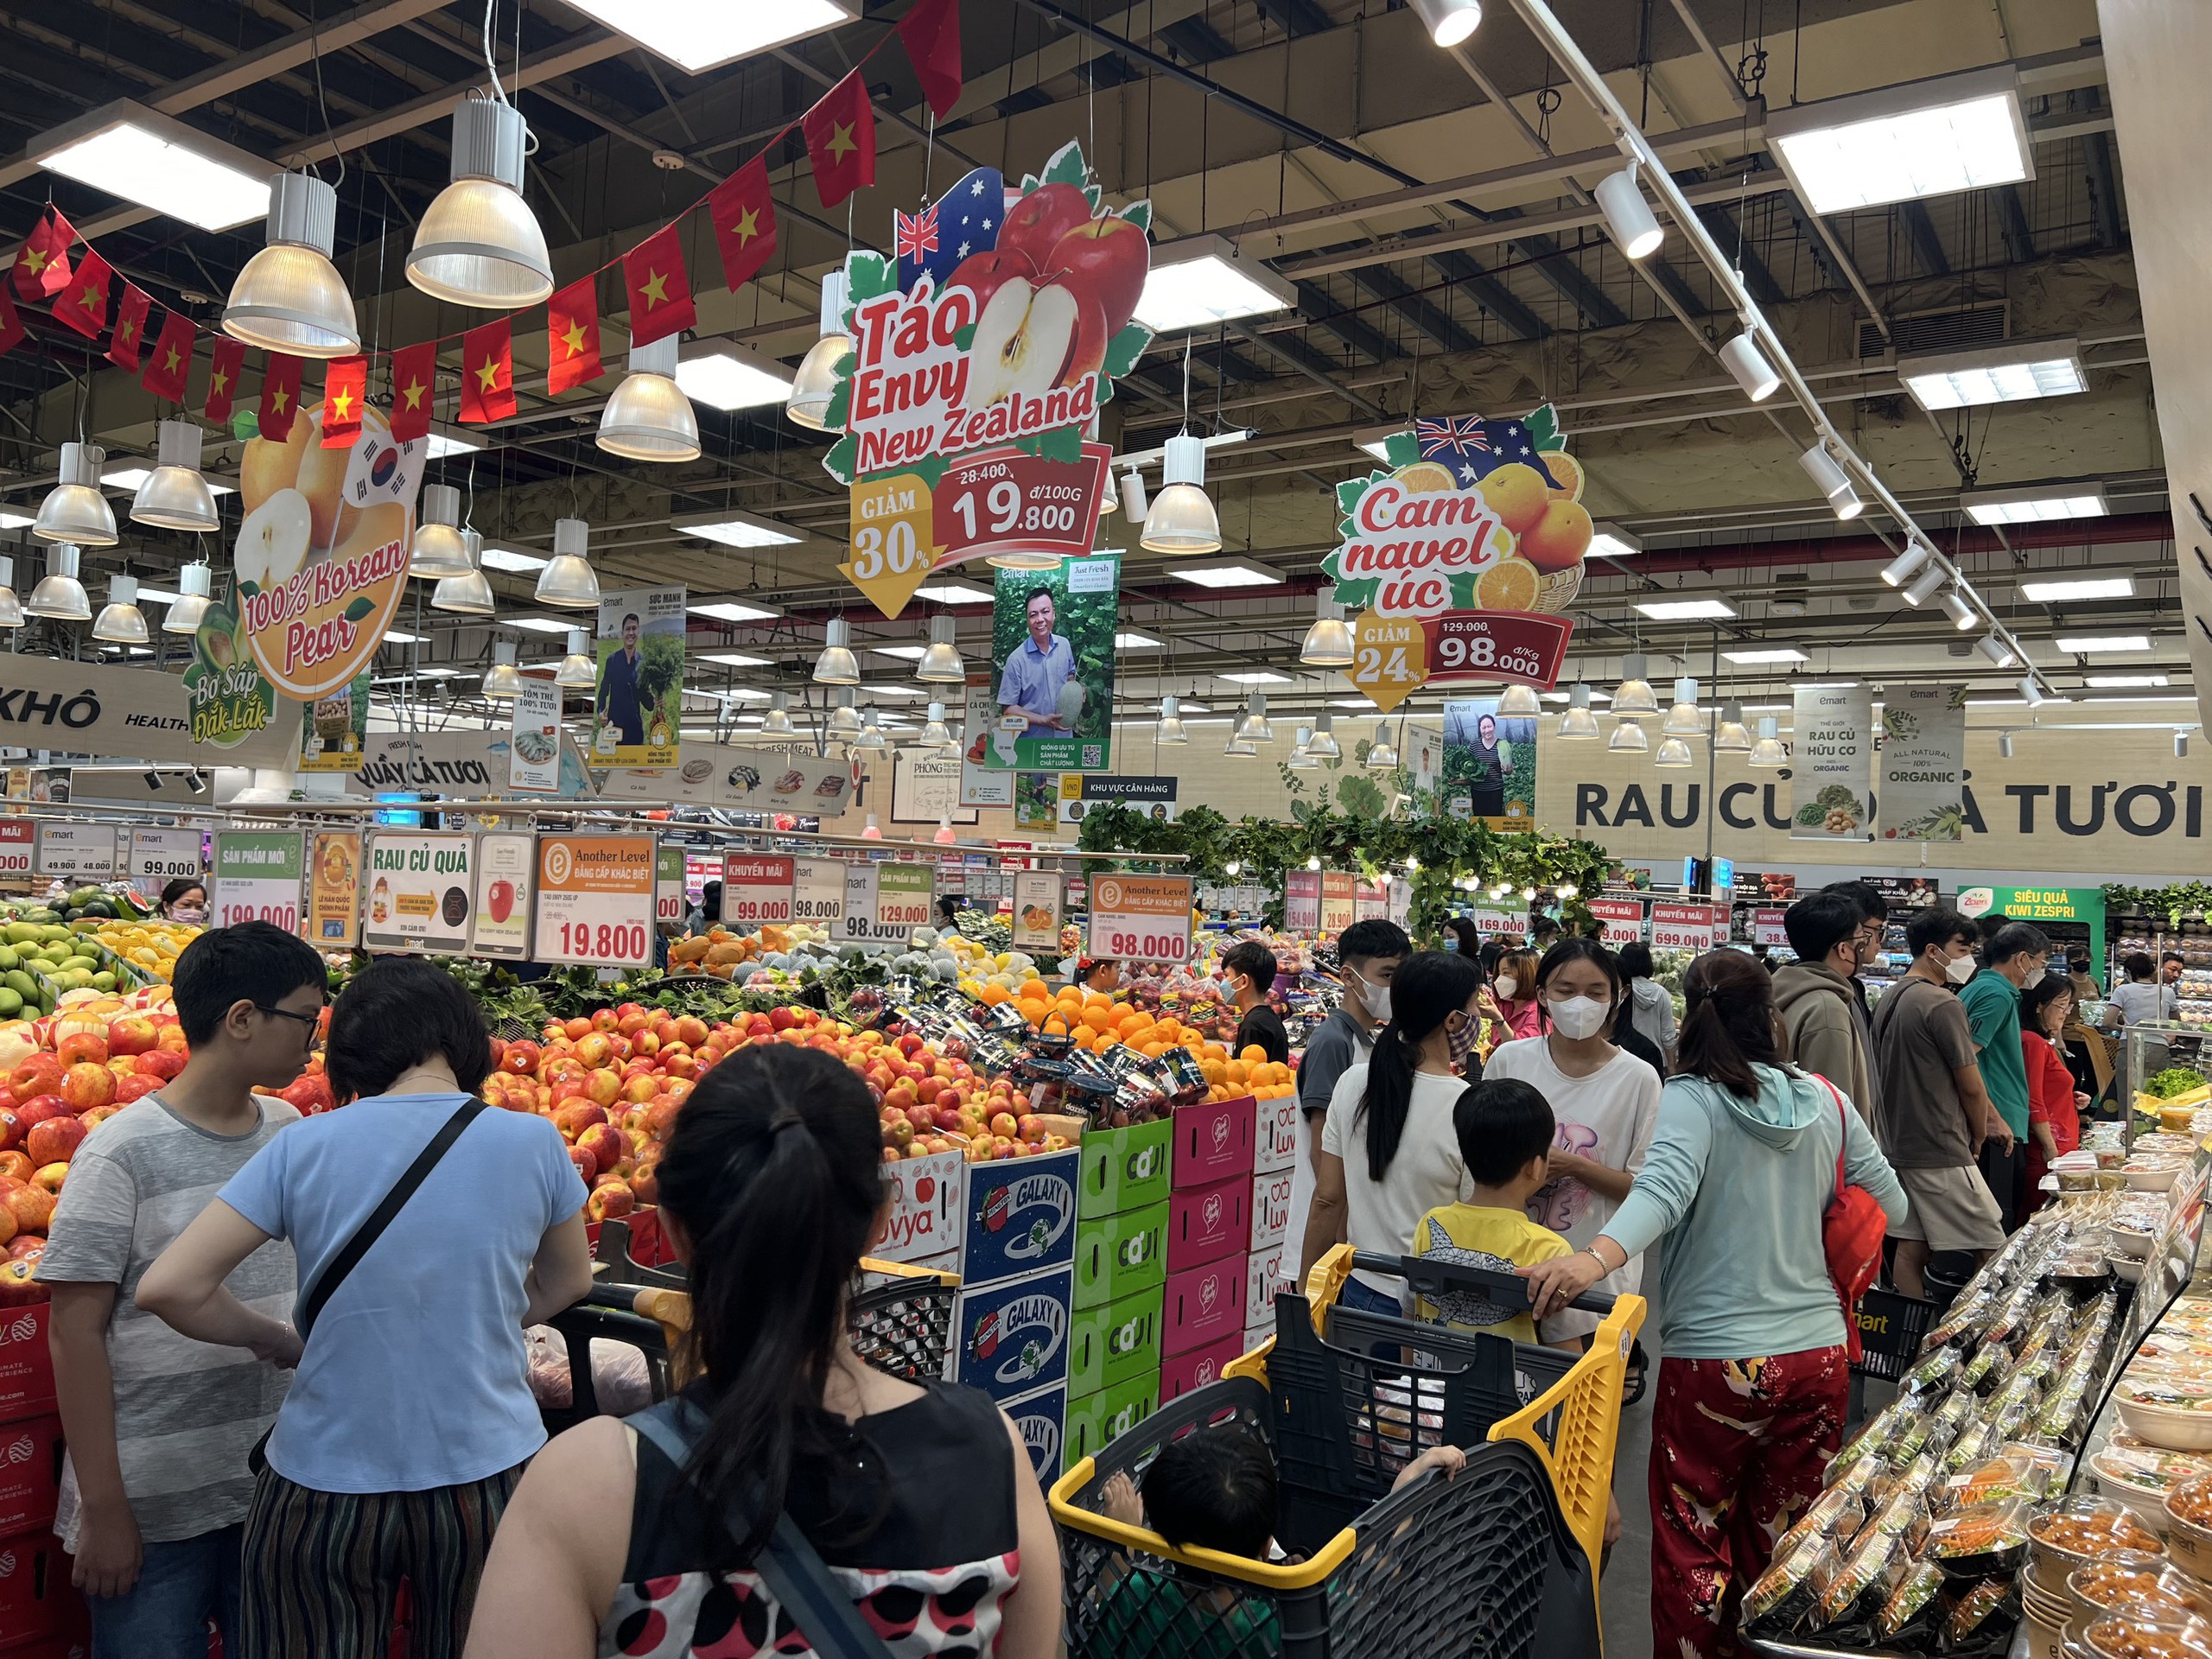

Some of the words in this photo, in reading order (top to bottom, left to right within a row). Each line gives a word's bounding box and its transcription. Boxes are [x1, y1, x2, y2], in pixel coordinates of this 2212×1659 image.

[861, 283, 969, 366] Táo
[855, 357, 969, 422] Envy
[861, 425, 934, 467] New
[940, 377, 1093, 452] Zealand
[960, 463, 1006, 485] 28.400
[1030, 485, 1082, 501] đ/100G
[861, 486, 915, 518] GIẢM
[1361, 486, 1482, 531] Cam
[855, 521, 929, 579] 30%
[1344, 519, 1493, 572] navel
[1075, 565, 1087, 574] Just
[1089, 563, 1109, 573] Fresh
[245, 569, 312, 636] 100%
[315, 541, 405, 602] Korean
[1382, 569, 1444, 611] úc
[604, 596, 623, 607] emart
[1364, 623, 1410, 641] GIẢM
[1442, 622, 1488, 632] 129.000
[285, 620, 356, 673] Pear
[1513, 646, 1540, 660] đ/Kg
[1356, 647, 1420, 683] 24%
[196, 673, 219, 706] Bơ
[224, 664, 258, 698] Sáp
[0, 688, 101, 728] KHÔ
[519, 699, 537, 708] 100%
[1820, 696, 1847, 705] emart
[194, 702, 228, 743] Đắk
[233, 693, 268, 731] Lắk
[1808, 731, 1835, 741] RAU
[1839, 727, 1855, 741] CỦ
[388, 741, 406, 751] FRESH
[407, 741, 423, 750] FSH
[791, 745, 814, 756] MEAT
[1808, 744, 1835, 756] HỮU
[1839, 745, 1857, 755] CƠ
[1911, 749, 1952, 760] NATURAL
[433, 760, 490, 784] TƯƠI
[1888, 772, 1955, 783] ORGANIC
[1108, 784, 1125, 793] VỰC
[1127, 782, 1142, 792] CÂN
[1144, 782, 1168, 793] HÀNG
[1576, 784, 1700, 829] RAU
[2005, 781, 2202, 837] TƯƠI
[2, 827, 21, 836] MÃI
[45, 830, 73, 840] emart
[136, 834, 162, 843] emart
[223, 847, 239, 864] SẢN
[242, 844, 266, 864] PHẨM
[268, 847, 285, 864] MỚI
[373, 849, 405, 870] RAU
[410, 842, 430, 872] CỦ
[435, 843, 467, 874] QUẢ
[575, 849, 618, 862] Another
[620, 850, 650, 862] Level
[144, 861, 195, 876] 99.000
[575, 863, 594, 879] ĐẲNG
[595, 865, 609, 879] CẤP
[611, 866, 631, 880] KHÁC
[632, 868, 650, 882] BIỆT
[728, 861, 764, 877] KHUYẾN
[766, 864, 783, 877] MÃI
[880, 872, 893, 883] SẢN
[893, 872, 909, 883] PHẨM
[1125, 886, 1160, 895] Another
[1163, 887, 1187, 897] Level
[2014, 889, 2042, 903] SIÊU
[2043, 889, 2068, 905] QUẢ
[738, 902, 789, 919] 99.000
[796, 900, 840, 918] 98.000
[1141, 897, 1154, 906] CẤP
[1155, 898, 1173, 906] KHÁC
[1173, 899, 1187, 908] BIỆT
[222, 904, 296, 934] 199000
[880, 906, 927, 923] 129.000
[1617, 906, 1631, 916] MÃI
[1656, 909, 1685, 919] KHUYẾN
[1688, 912, 1702, 920] MÃI
[2005, 905, 2032, 917] KIWI
[2034, 906, 2075, 918] ZESPRI
[1287, 912, 1316, 927] 154.900
[1327, 912, 1351, 928] 28.900
[1478, 918, 1524, 932] 169.000
[404, 938, 424, 949] emart
[561, 922, 645, 960] 19.800
[1111, 933, 1185, 959] 98.000
[1656, 933, 1708, 947] 699.000
[1065, 1103, 1088, 1115] dazzle
[1016, 1178, 1063, 1208] GALAXY
[1007, 1299, 1053, 1332] GALAXY
[1853, 1313, 1889, 1334] mart
